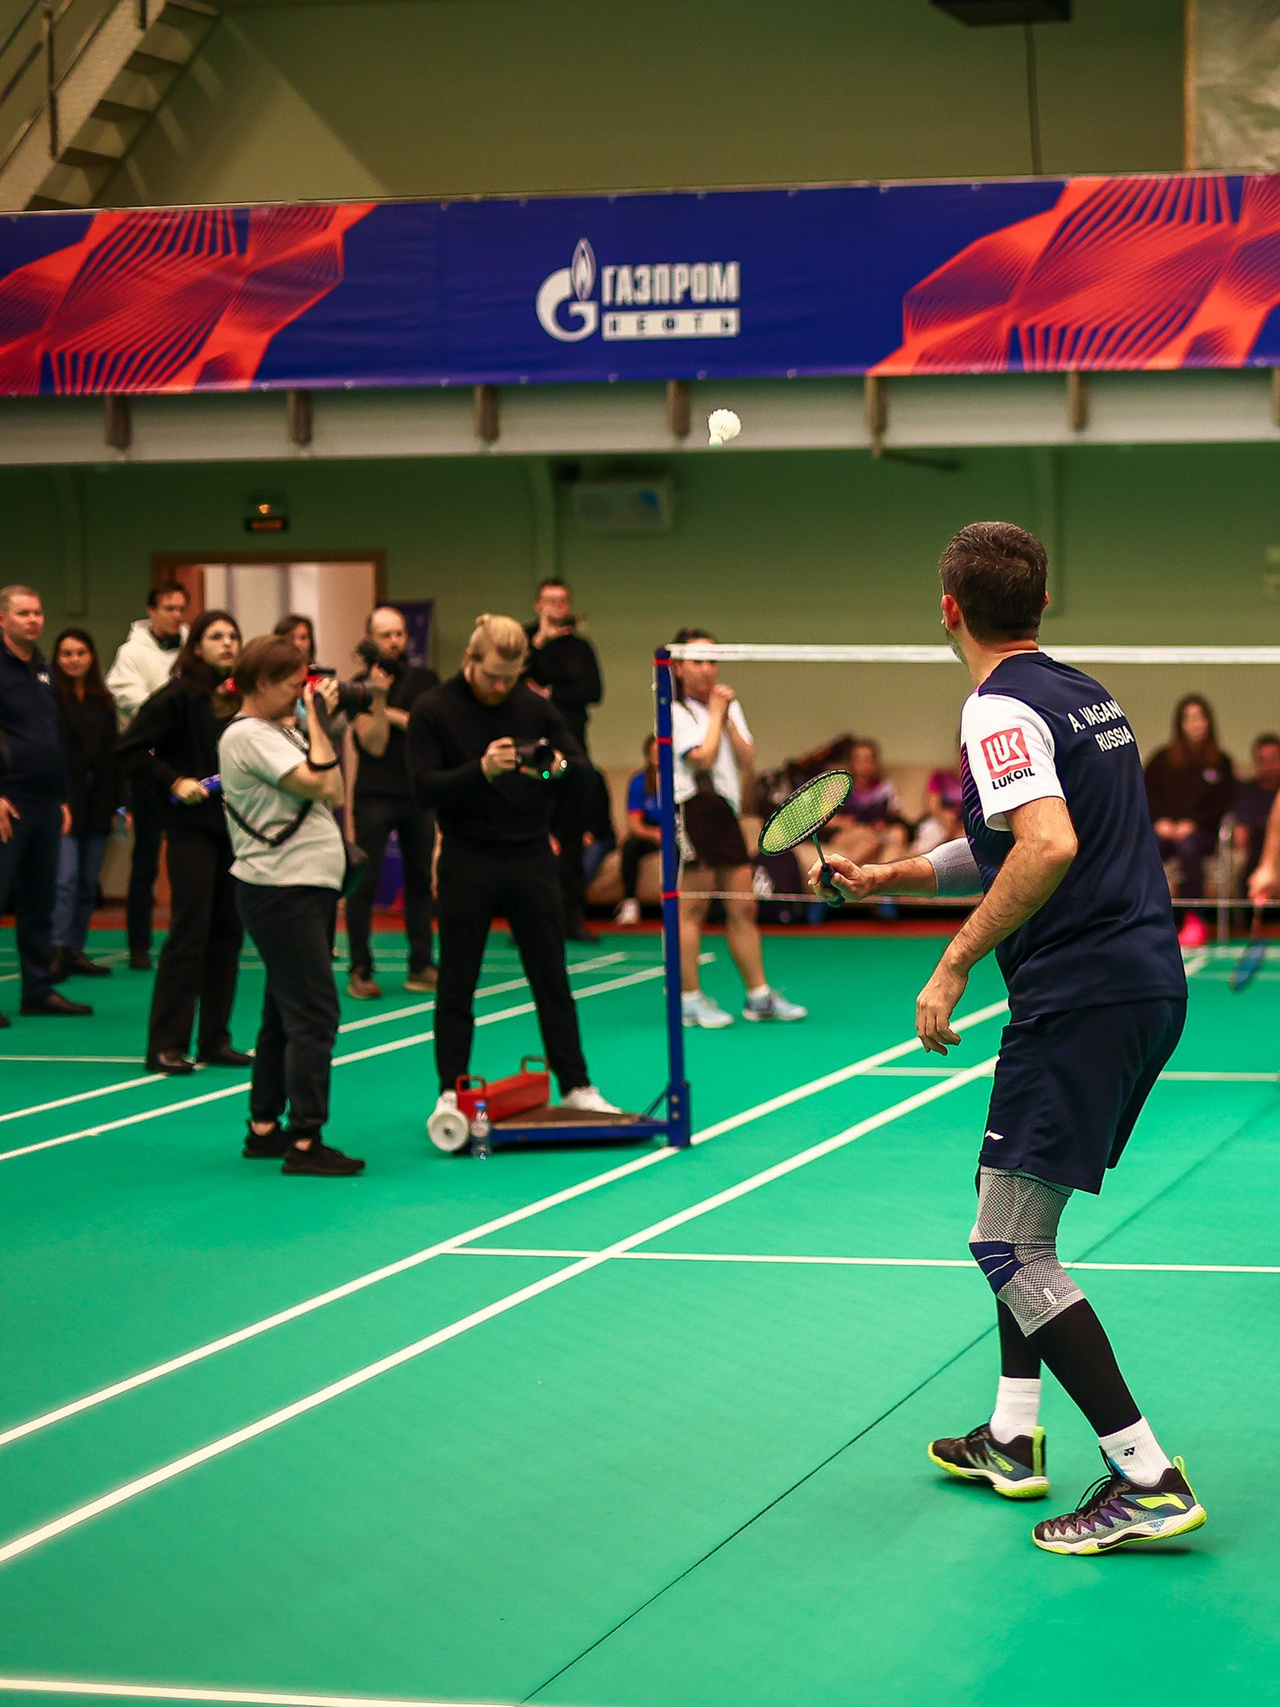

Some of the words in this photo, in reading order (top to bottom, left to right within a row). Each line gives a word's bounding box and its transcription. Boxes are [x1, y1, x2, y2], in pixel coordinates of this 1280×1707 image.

[601, 261, 741, 306] ГАЗПРОМ
[1067, 712, 1086, 733] A.
[1094, 725, 1135, 752] RUSSIA
[992, 767, 1036, 790] LUKOIL
